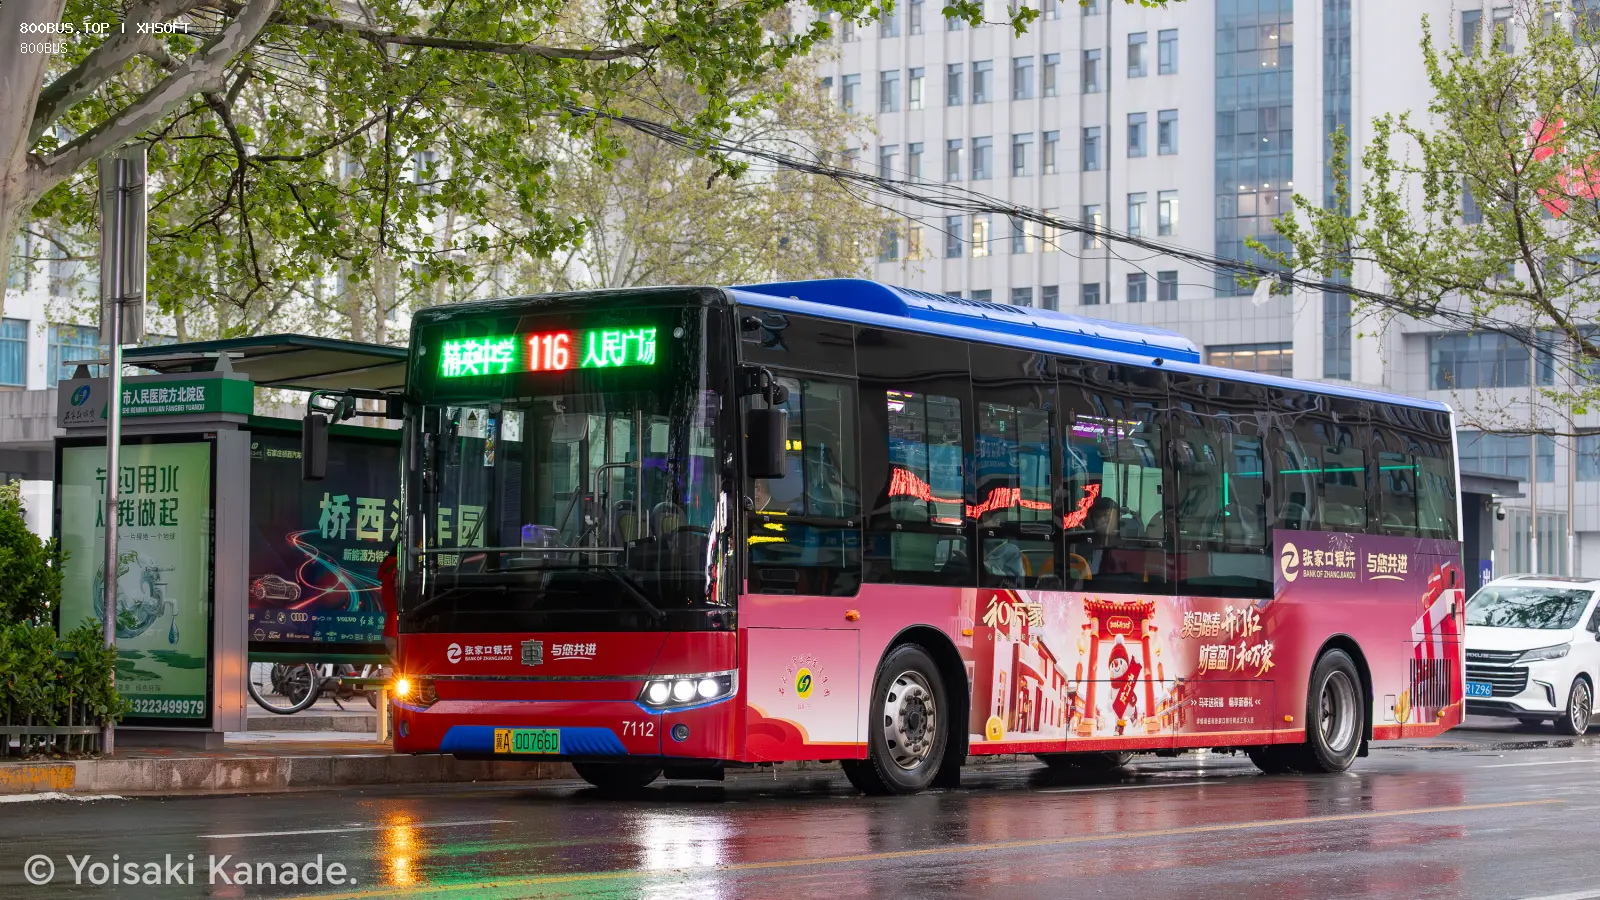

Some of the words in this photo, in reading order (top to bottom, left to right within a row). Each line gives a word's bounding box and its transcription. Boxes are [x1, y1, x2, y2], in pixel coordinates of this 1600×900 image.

[441, 337, 515, 377] 精英中学
[529, 333, 569, 371] 116
[582, 326, 657, 368] 人民广场
[122, 386, 205, 405] 市人民医院方北院区
[1302, 549, 1356, 569] 张家口银行
[1366, 552, 1408, 574] 与您共进
[1303, 569, 1317, 578] BANK
[1317, 570, 1324, 578] OF
[1324, 570, 1356, 579] ZHANGJIAKOU
[268, 630, 282, 639] Ford
[464, 645, 513, 656] 张家口银行
[551, 643, 597, 656] 与您共进
[622, 721, 654, 737] 7112
[516, 732, 559, 750] 00766D
